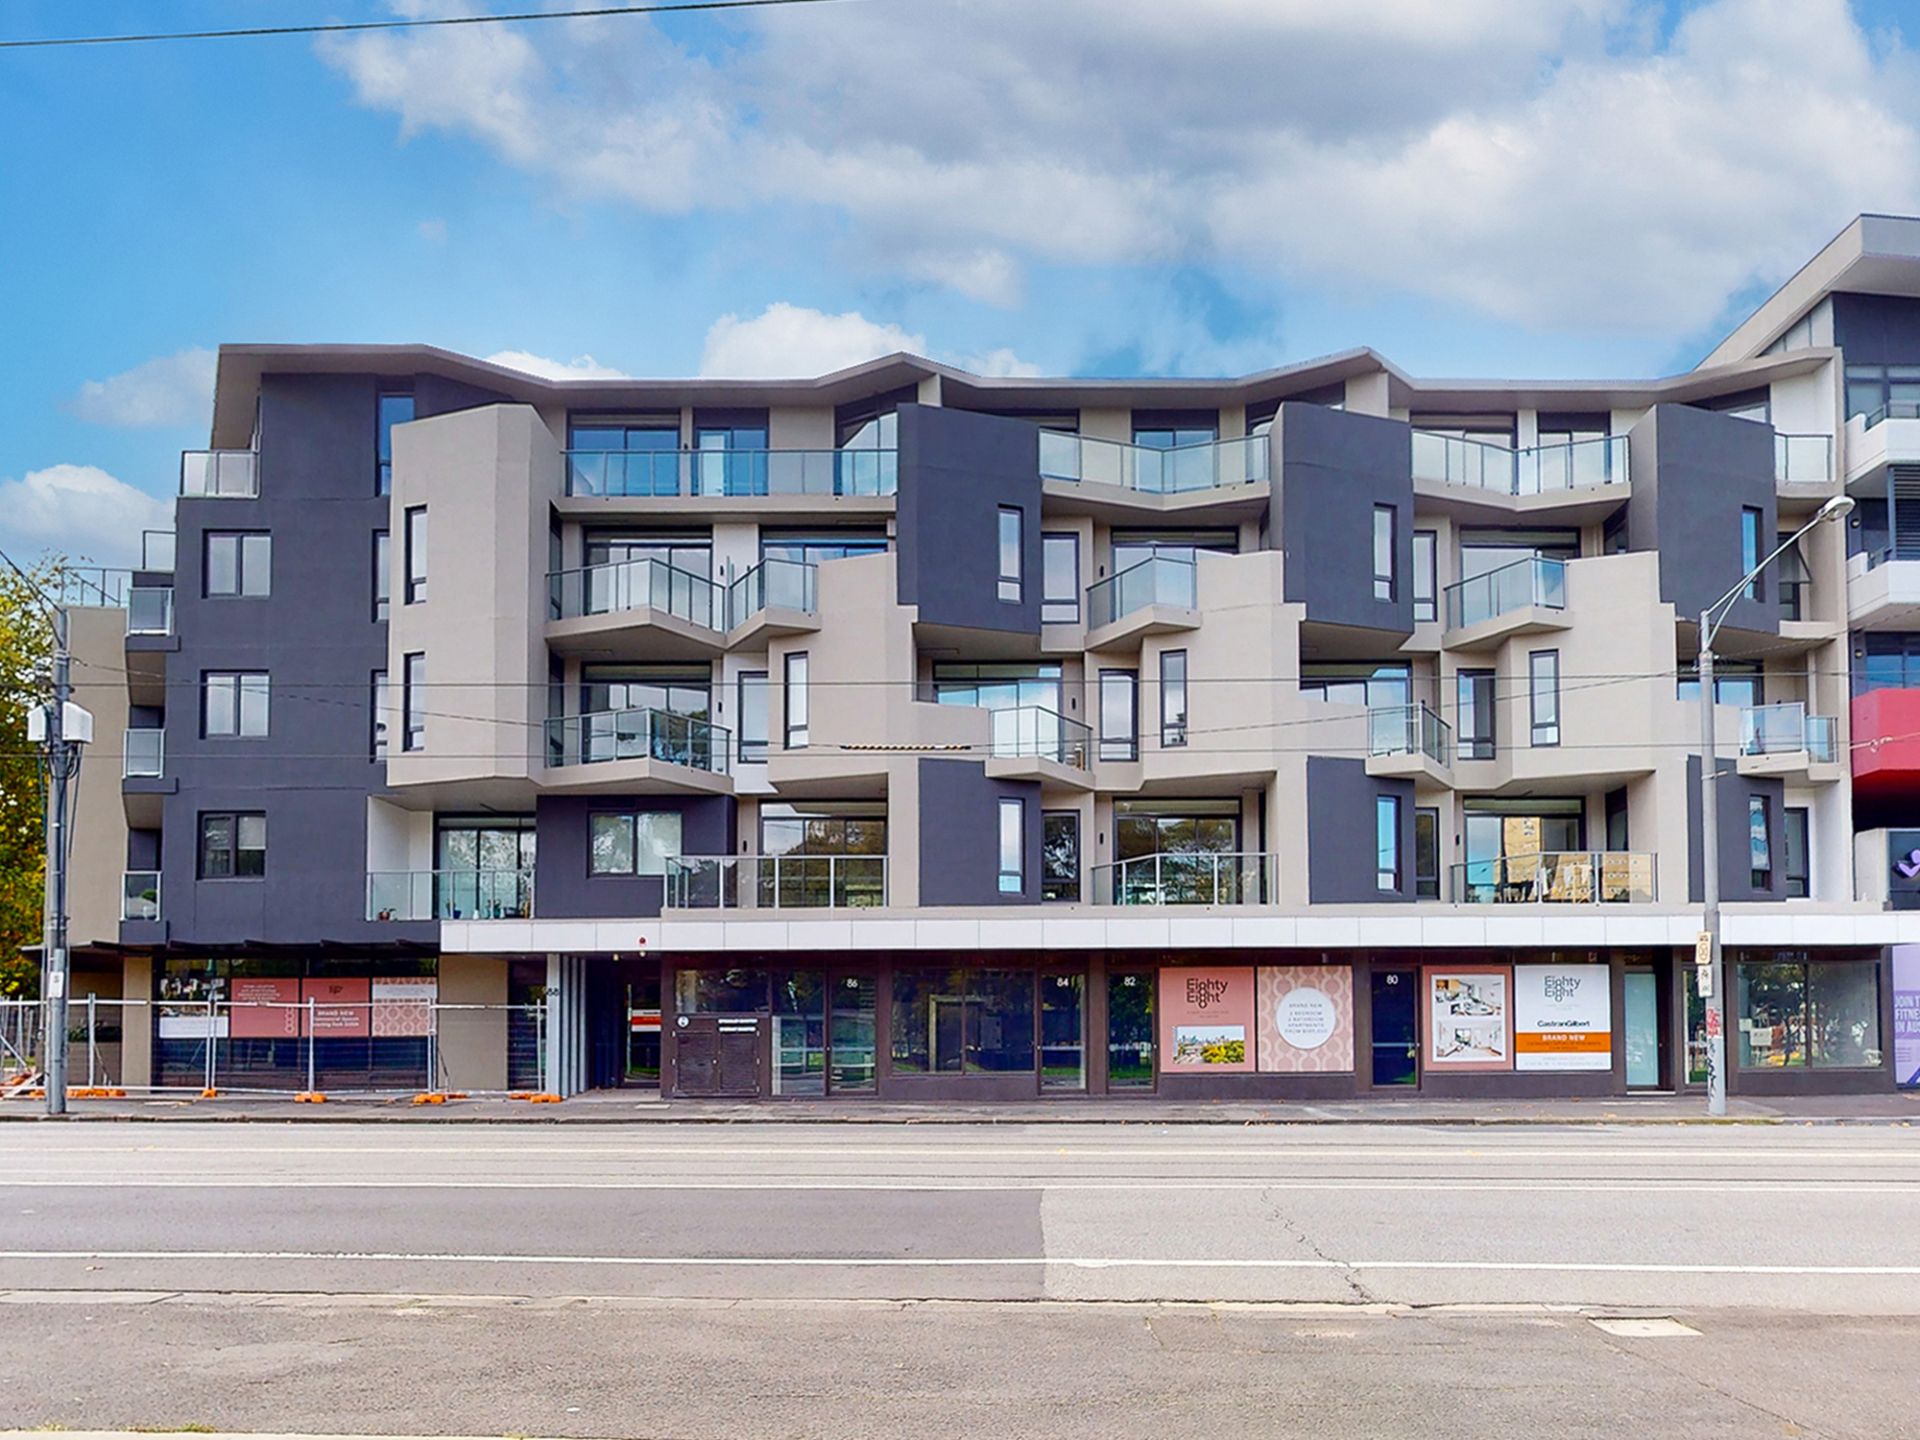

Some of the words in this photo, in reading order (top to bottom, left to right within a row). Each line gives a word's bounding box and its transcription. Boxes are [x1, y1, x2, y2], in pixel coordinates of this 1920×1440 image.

[846, 978, 858, 988] 86
[1057, 977, 1069, 987] 84
[1124, 976, 1136, 986] 82
[1386, 974, 1399, 985] 80
[1544, 976, 1581, 990] Eighty
[1186, 978, 1228, 995] Eighty
[1186, 991, 1221, 1009] Eight
[1544, 987, 1574, 1002] Eight
